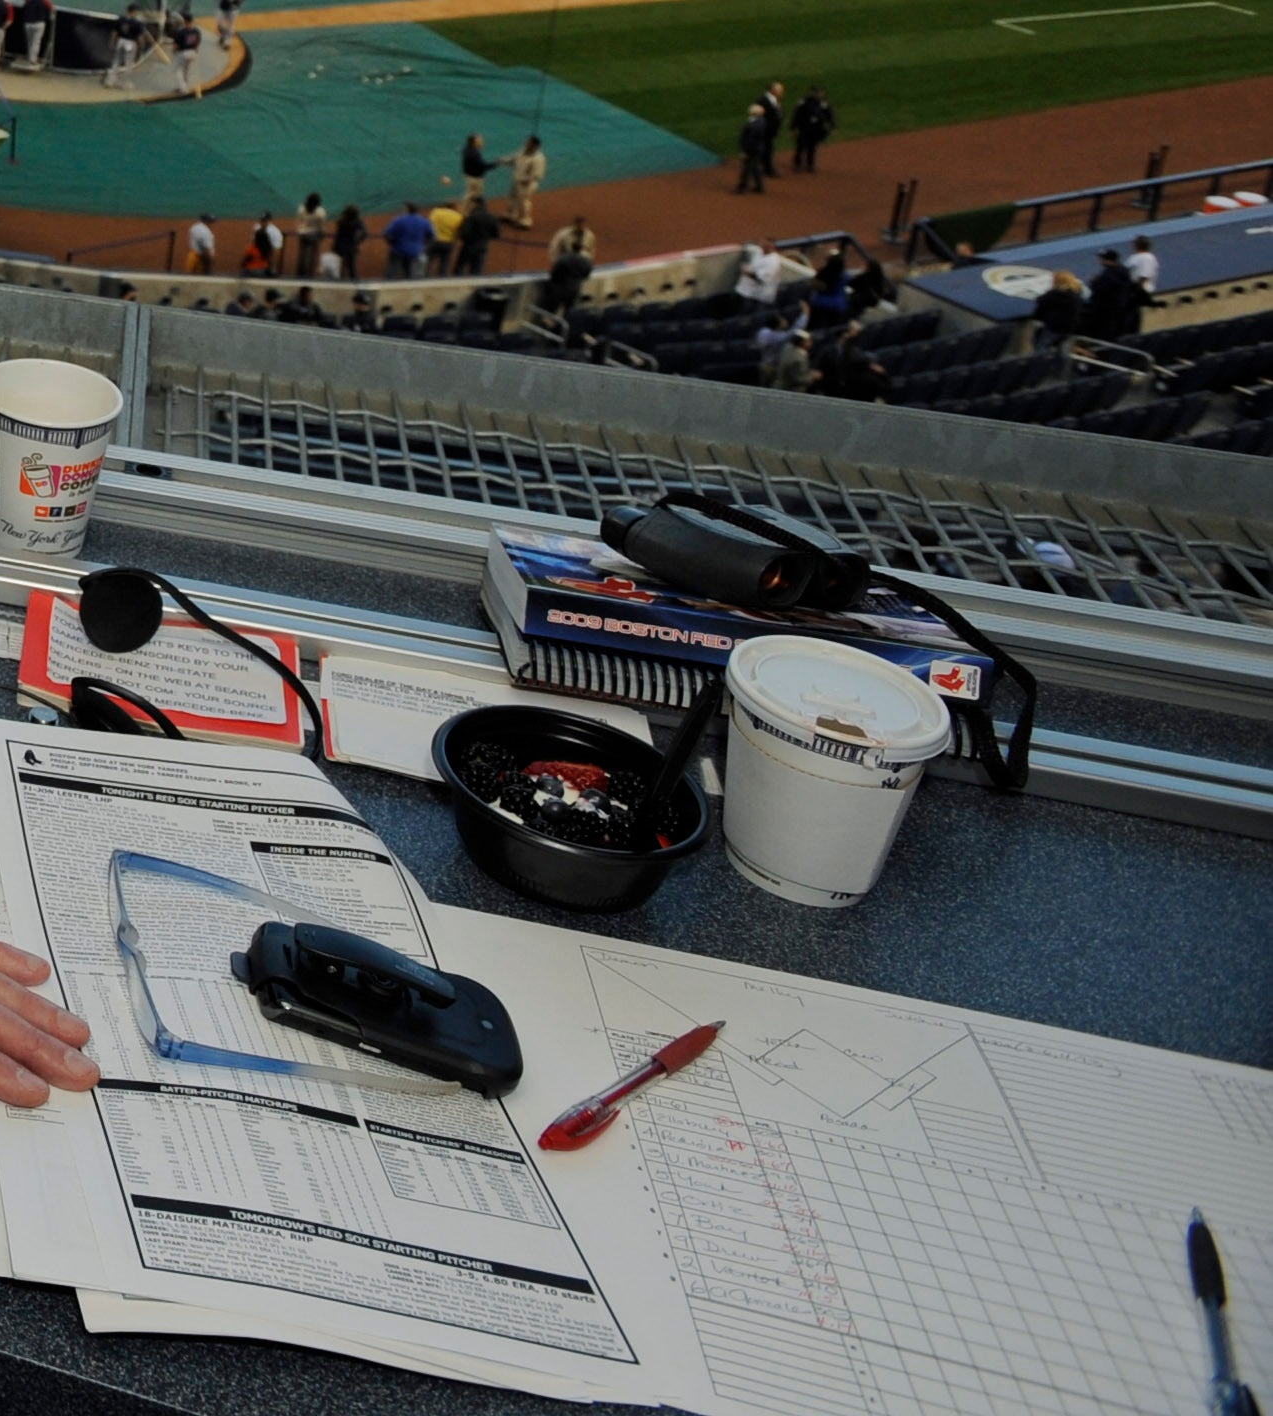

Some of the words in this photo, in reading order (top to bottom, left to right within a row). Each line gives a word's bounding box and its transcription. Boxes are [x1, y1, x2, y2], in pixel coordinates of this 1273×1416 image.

[0, 518, 27, 539] New
[26, 529, 62, 547] York
[54, 616, 85, 634] TODA
[177, 643, 210, 656] KEYS
[214, 648, 230, 658] TO
[234, 651, 259, 663] THE
[546, 608, 603, 628] 2009
[603, 616, 690, 644] BOSTON
[690, 631, 733, 651] RED
[50, 635, 151, 670] MERCEDES-BENZ
[154, 663, 217, 680] TRI-STATE
[52, 625, 84, 644] GAME
[131, 648, 191, 665] ONSORED
[193, 657, 209, 669] BY
[213, 660, 249, 673] YOUR
[49, 656, 113, 683] MERCEDES
[116, 676, 141, 689] DOT
[184, 691, 221, 704] YOUR
[222, 697, 278, 713] SOURCE
[50, 668, 71, 683] FOR
[51, 646, 103, 670] DEALERS
[115, 666, 133, 677] ON
[137, 670, 160, 683] THE
[164, 676, 193, 689] WEB
[194, 681, 210, 691] AT
[214, 684, 267, 701] SEARCH
[22, 784, 54, 795] 31-JON
[56, 789, 92, 801] LESTER,
[101, 786, 153, 800] TONIGHT'S
[155, 793, 176, 804] RED
[177, 796, 198, 806] SOX
[199, 799, 249, 813] STARTING
[251, 805, 296, 815] PITCHER
[269, 845, 305, 855] INSIDE
[307, 847, 327, 857] THE
[329, 849, 377, 862] NUMBERS
[159, 1084, 244, 1104] BATTER-PITCHER
[244, 1093, 299, 1112] MATCHUPS
[368, 1124, 415, 1140] STARTING
[415, 1134, 463, 1151] PITCHERS'
[464, 1144, 522, 1162] BREAKDOWN
[137, 1209, 209, 1226] 18-DAISUKE
[211, 1219, 286, 1240] MATSUZAKA,
[289, 1232, 315, 1244] RHP
[229, 1209, 317, 1235] TOMORROW'S
[317, 1226, 344, 1241] RED
[344, 1233, 371, 1247] SOX
[372, 1239, 436, 1262] STARTING
[437, 1253, 494, 1273] PITCHER
[689, 1212, 747, 1242] Bay
[674, 1234, 689, 1250] 9
[696, 1237, 759, 1262] Drew
[681, 1255, 696, 1269] 2
[454, 1269, 480, 1283] 3-5,
[482, 1274, 509, 1286] 6.80
[512, 1279, 541, 1294] ERA,
[543, 1286, 558, 1297] 10
[560, 1291, 596, 1304] starts
